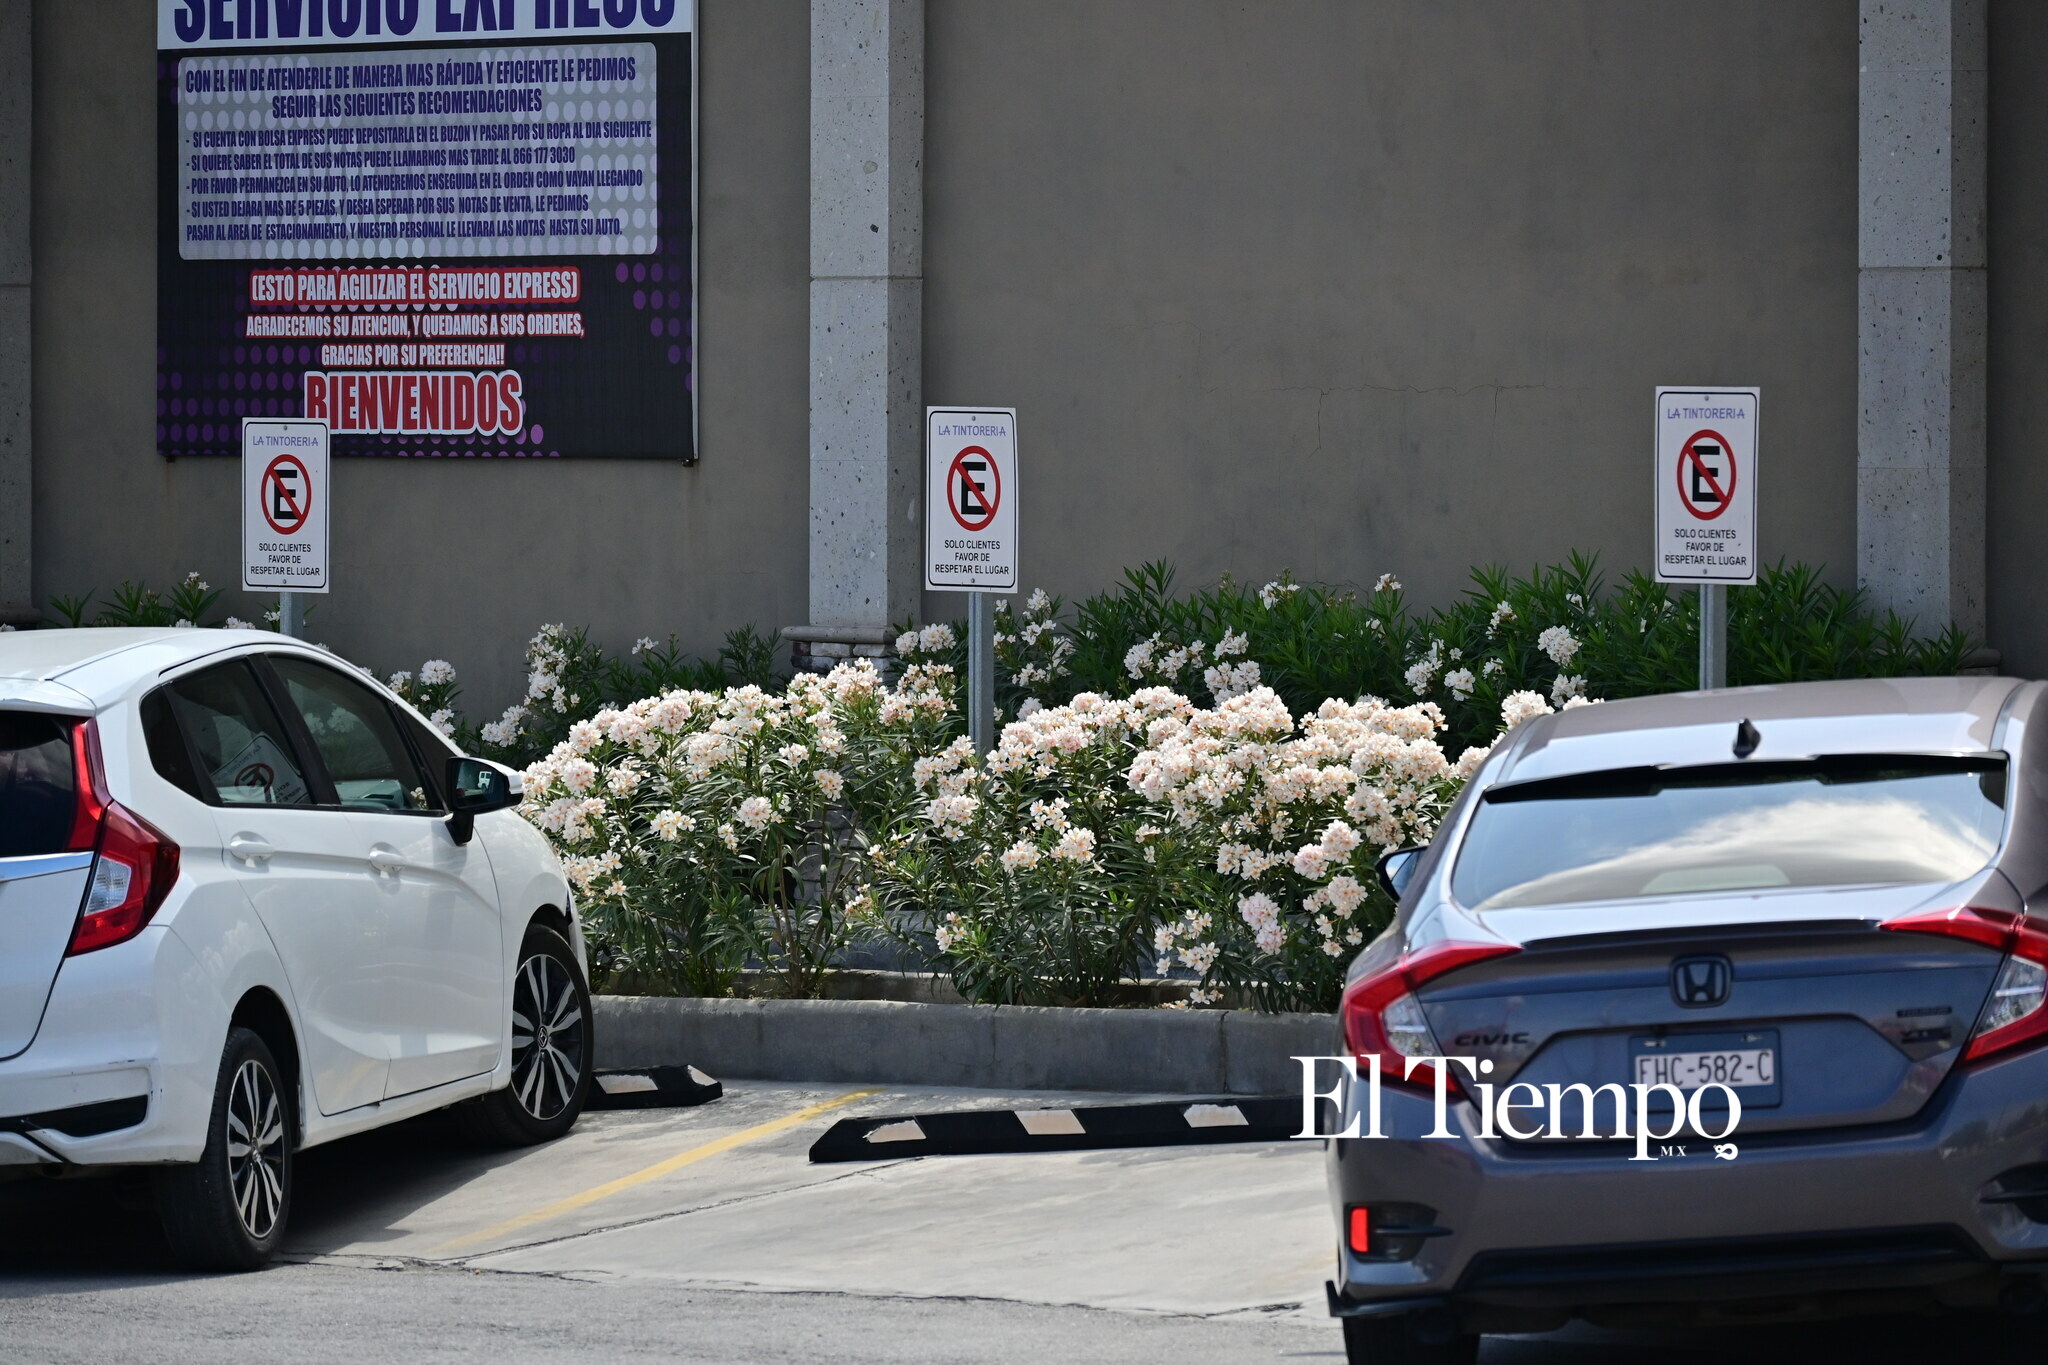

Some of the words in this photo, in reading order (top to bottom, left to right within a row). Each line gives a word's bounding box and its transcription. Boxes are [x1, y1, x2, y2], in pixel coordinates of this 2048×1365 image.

[186, 70, 210, 93] CON
[214, 70, 225, 92] EL
[228, 69, 246, 91] FIN
[250, 69, 265, 91] DE
[267, 67, 332, 90] ATENDERLE
[335, 66, 349, 89] DE
[352, 64, 402, 88] MANERA
[406, 63, 433, 86] MAS
[436, 59, 482, 86] RÁPIDA
[486, 61, 494, 84] Y
[497, 60, 558, 84] EFICIENTE
[561, 59, 574, 82] LE
[577, 57, 636, 81] PEDIMOS
[272, 96, 316, 119] SEGUIR
[319, 94, 341, 117] LAS
[344, 92, 415, 117] SIGUIENTES
[418, 88, 542, 114] RECOMENDACIONES
[193, 131, 202, 148] SI
[203, 130, 236, 148] CUENTA
[238, 130, 256, 147] CON
[259, 130, 286, 146] BOLSA
[288, 129, 325, 146] EXPRESS
[327, 128, 354, 145] PUEDE
[356, 127, 414, 145] DEPOSITARLA
[417, 126, 428, 143] EN
[429, 126, 439, 142] EL
[441, 125, 470, 142] BUZON
[472, 125, 478, 141] Y
[480, 124, 510, 141] PASAR
[512, 124, 530, 141] POR
[532, 123, 545, 140] SU
[546, 123, 571, 140] ROPA
[572, 122, 584, 139] AL
[586, 122, 601, 138] DIA
[603, 121, 652, 138] SIGUIENTE
[191, 155, 200, 171] SI
[202, 154, 232, 172] QUIERE
[233, 153, 261, 170] SABER
[263, 153, 272, 169] EL
[274, 153, 300, 169] TOTAL
[302, 152, 312, 169] DE
[314, 152, 332, 168] SUS
[334, 151, 362, 168] NOTAS
[364, 150, 391, 168] PUEDE
[394, 149, 446, 167] LLAMARNOS
[449, 149, 468, 165] MAS
[470, 148, 499, 165] TARDE
[501, 148, 511, 164] AL
[513, 147, 532, 164] 866
[534, 147, 548, 163] 177
[550, 146, 575, 163] 3030
[192, 178, 209, 194] POR
[211, 177, 238, 193] FAVOR
[239, 176, 295, 193] PERMANEZCA
[298, 176, 308, 192] EN
[310, 176, 322, 192] SU
[324, 175, 349, 193] AUTO,
[350, 175, 360, 191] LO
[363, 173, 425, 191] ATENDEREMOS
[428, 172, 478, 190] ENSEGUIDA
[480, 172, 491, 189] EN
[493, 172, 502, 189] EL
[504, 171, 534, 189] ORDEN
[536, 171, 564, 188] COMO
[566, 170, 595, 187] VAYAN
[597, 169, 643, 187] LLEGANDO
[191, 201, 200, 218] SI
[202, 200, 230, 217] USTED
[231, 200, 263, 217] DEJARA
[264, 200, 284, 216] MAS
[286, 199, 297, 216] DE
[298, 199, 304, 216] 5
[306, 199, 338, 217] PIEZAS,
[339, 199, 345, 215] Y
[347, 198, 374, 215] DESEA
[376, 197, 415, 214] ESPERAR
[417, 197, 435, 214] POR
[436, 196, 455, 214] SUS
[458, 195, 488, 213] NOTAS
[490, 195, 501, 213] DE
[503, 195, 534, 214] VENTA,
[536, 194, 545, 211] LE
[547, 194, 589, 211] PEDIMOS
[187, 225, 214, 241] PASAR
[216, 224, 226, 240] AL
[228, 224, 249, 240] AREA
[252, 224, 262, 240] DE
[266, 222, 349, 241] ESTACIONAMIENTO,
[350, 222, 355, 239] Y
[357, 222, 397, 239] NUESTRO
[400, 221, 444, 238] PERSONAL
[447, 221, 456, 237] LE
[458, 220, 495, 237] LLEVARA
[497, 220, 514, 236] LAS
[516, 219, 545, 236] NOTAS
[549, 218, 579, 236] HASTA
[581, 218, 593, 235] SU
[595, 217, 623, 235] AUTO.
[252, 274, 294, 301] (ESTO
[298, 274, 336, 300] PARA
[339, 273, 406, 300] AGILIZAR
[410, 273, 425, 299] EL
[428, 272, 500, 299] SERVICIO
[504, 271, 578, 299] EXPRESS)
[246, 315, 331, 337] AGRADECEMOS
[333, 315, 349, 336] SU
[351, 314, 411, 338] ATENCION,
[412, 315, 420, 335] Y
[423, 314, 488, 337] QUEDAMOS
[489, 315, 498, 335] A
[501, 314, 525, 335] SUS
[527, 313, 585, 338] ORDENES,
[321, 344, 373, 366] GRACIAS
[375, 344, 399, 365] POR
[401, 344, 417, 365] SU
[419, 344, 504, 365] PREFERENCIA!!
[305, 371, 522, 435] BIENVENIDOS
[1667, 408, 1680, 419] LA
[938, 425, 950, 436] LA
[253, 436, 264, 446] LA
[1675, 529, 1696, 538] SOLO
[1698, 529, 1736, 539] CLIENTES
[259, 543, 277, 552] SOLO
[279, 543, 311, 552] CLIENTES
[944, 540, 965, 549] SOLO
[966, 540, 1000, 550] CLIENTES
[1686, 542, 1712, 551] FAVOR
[1713, 543, 1724, 552] DE
[269, 555, 290, 564] FAVOR
[292, 555, 301, 564] DE
[955, 552, 979, 562] FAVOR
[980, 553, 990, 562] DE
[1665, 554, 1705, 565] RESPETAR
[1707, 555, 1716, 565] EL
[1719, 556, 1746, 566] LUGAR
[251, 566, 285, 575] RESPETAR
[287, 567, 295, 575] EL
[296, 567, 320, 576] LUGAR
[935, 564, 973, 574] RESPETAR
[975, 565, 983, 574] EL
[985, 565, 1009, 575] LUGAR
[1455, 1032, 1529, 1046] CIVIC
[1640, 1052, 1770, 1086] FHC-582-C
